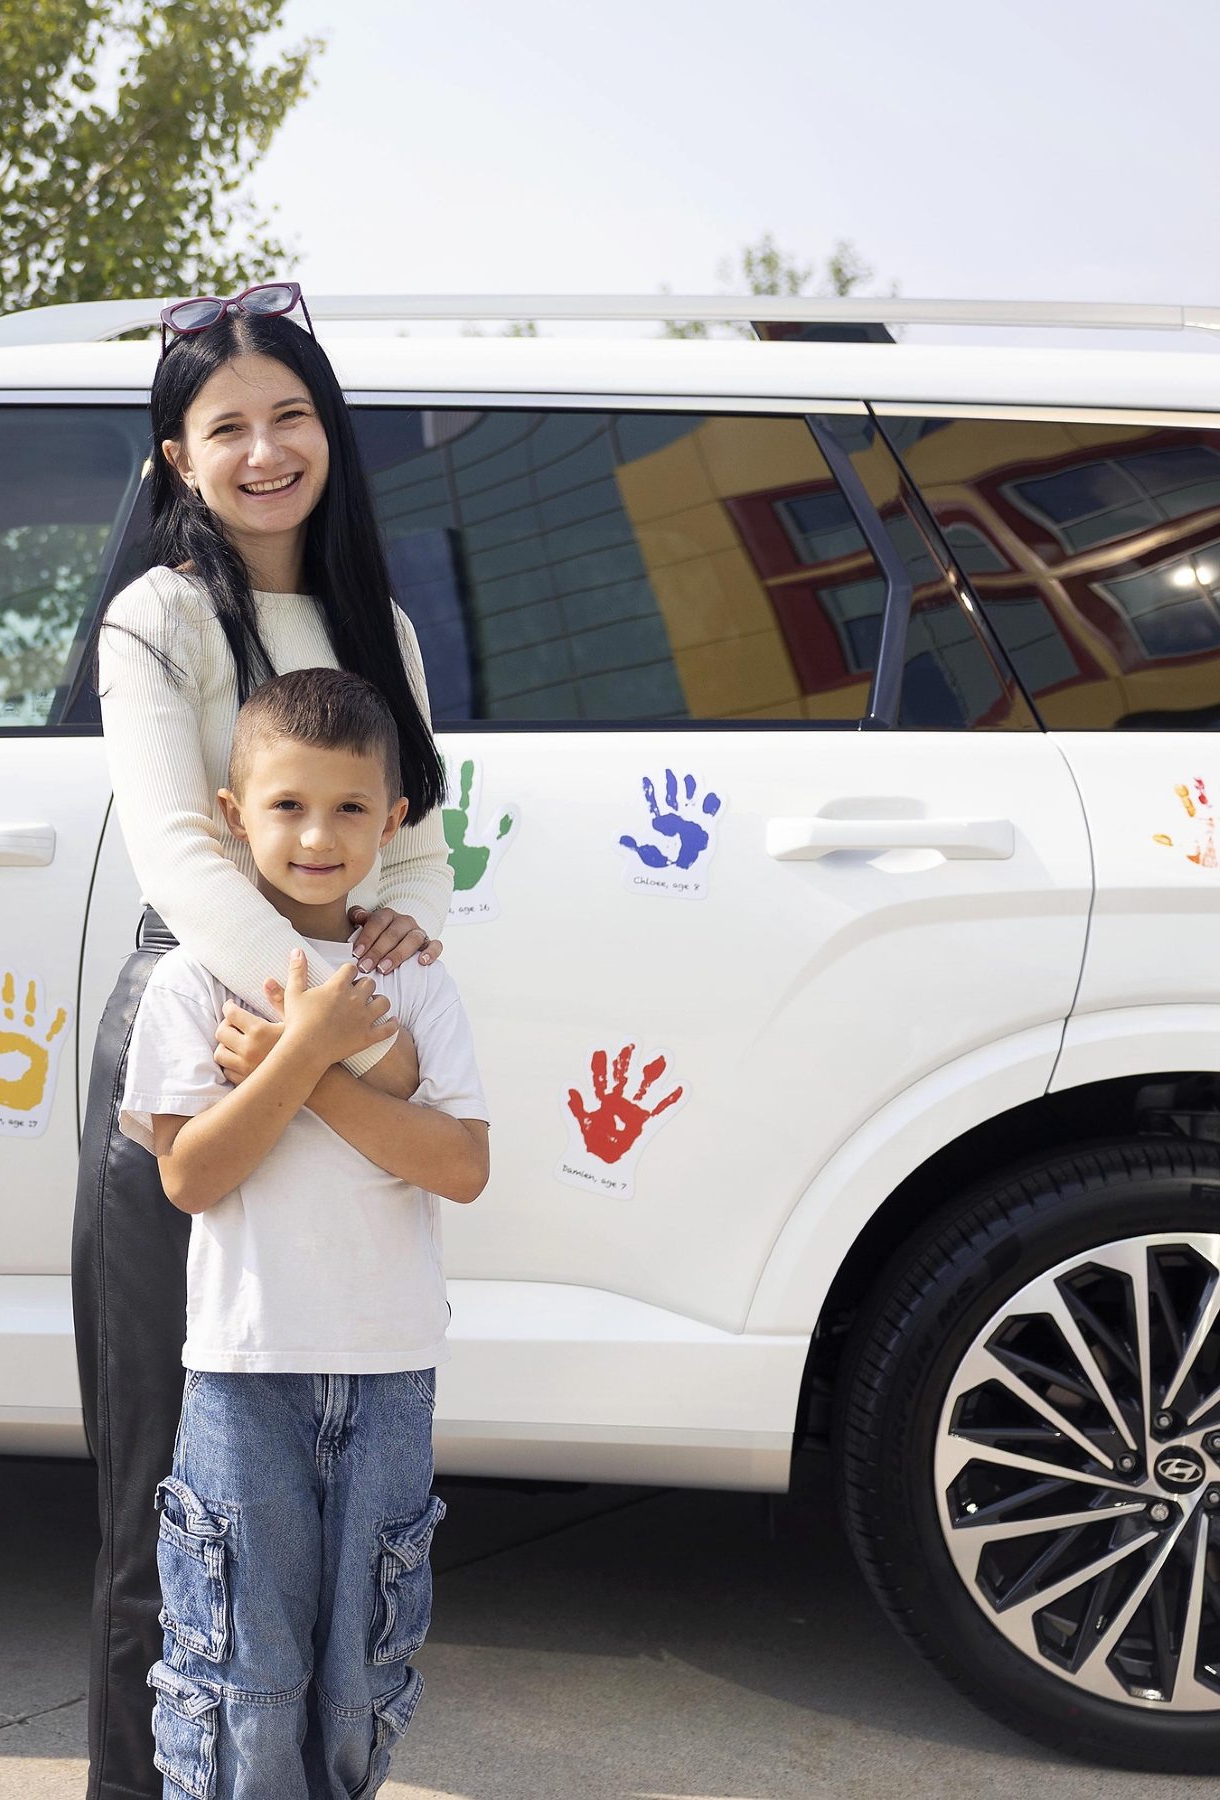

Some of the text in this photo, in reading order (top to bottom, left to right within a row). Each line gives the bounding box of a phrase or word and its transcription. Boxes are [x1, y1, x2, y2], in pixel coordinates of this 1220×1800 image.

[672, 883, 690, 892] age
[458, 905, 475, 916] age
[8, 1119, 24, 1129] age
[600, 1178, 618, 1189] age
